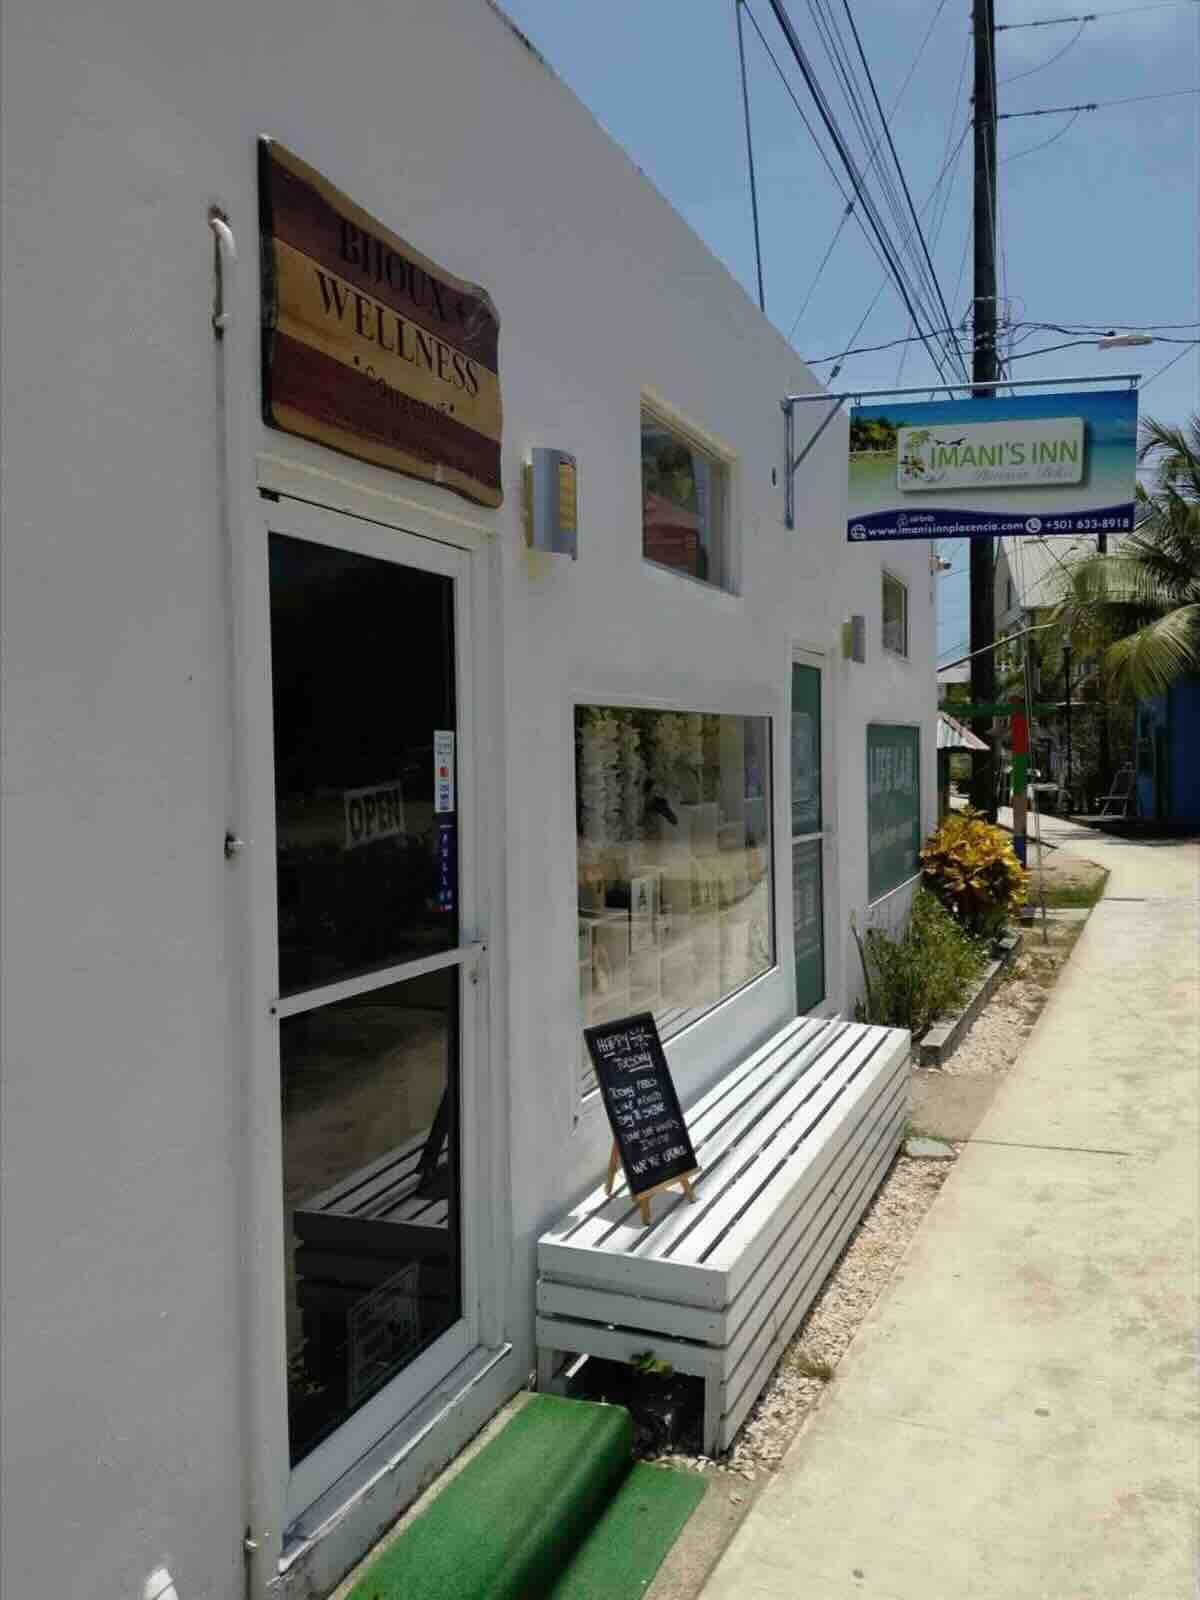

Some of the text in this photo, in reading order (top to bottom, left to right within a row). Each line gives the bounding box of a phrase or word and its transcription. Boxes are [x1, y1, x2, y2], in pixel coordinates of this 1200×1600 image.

[339, 222, 448, 322] BIJOUX
[314, 269, 480, 398] WELLNESS
[929, 439, 1078, 470] IMANI'S INN
[1045, 518, 1073, 531] +501
[1076, 516, 1130, 531] 633-8918
[349, 789, 401, 839] OPEN
